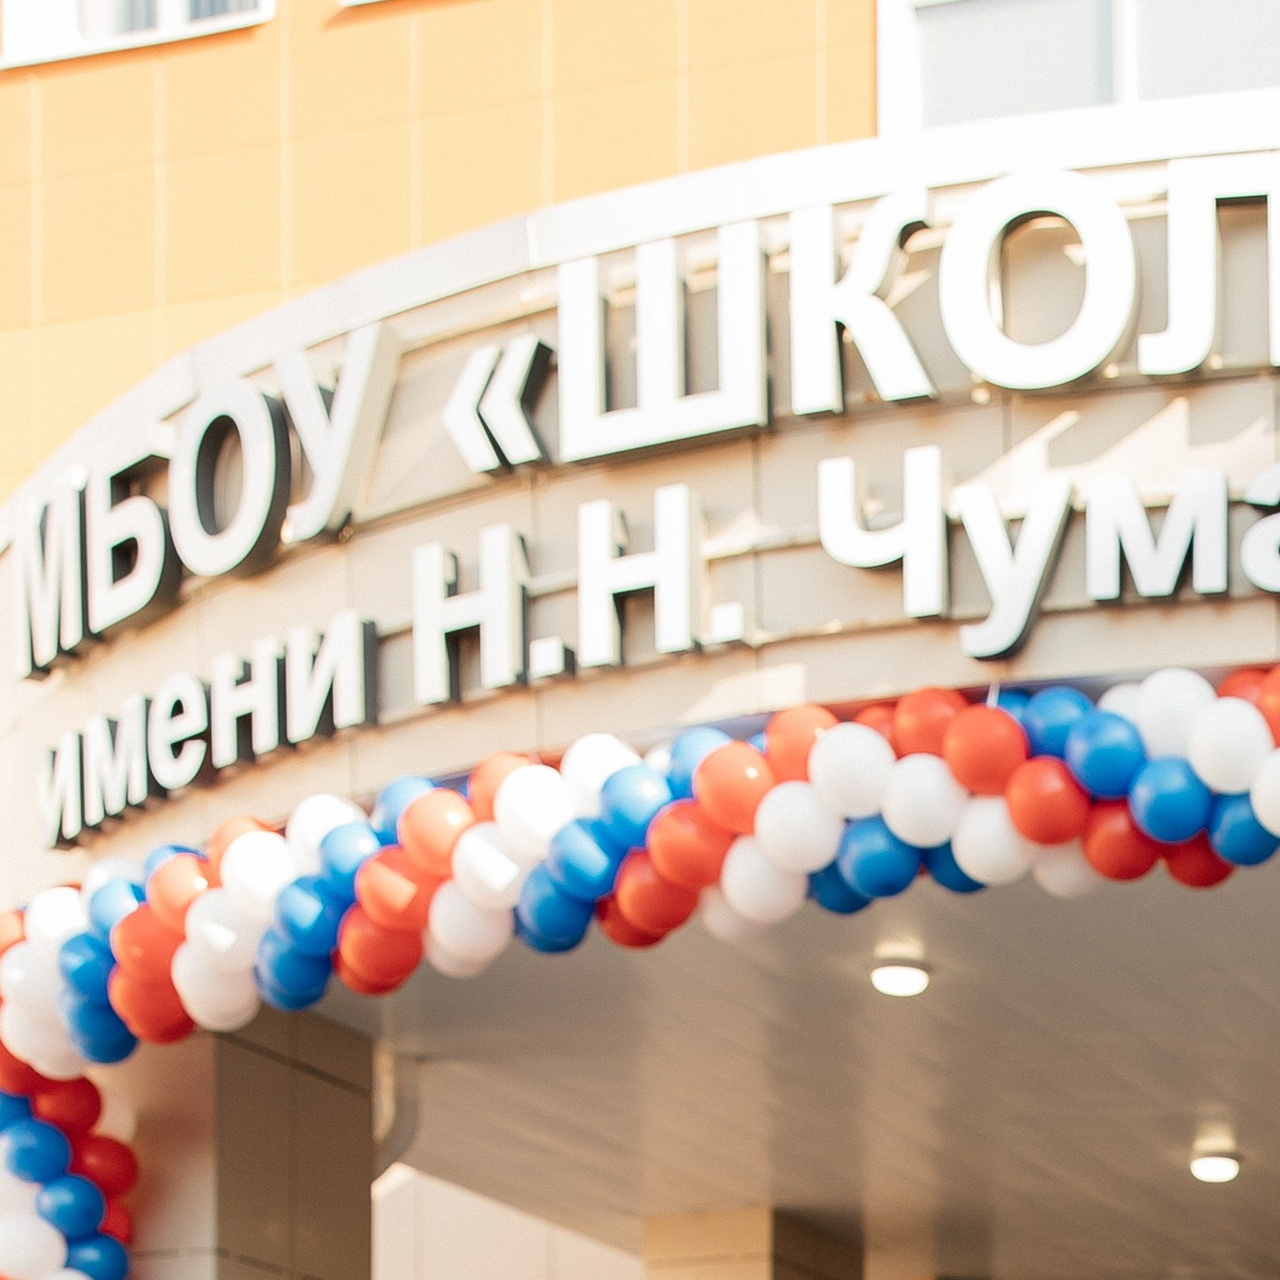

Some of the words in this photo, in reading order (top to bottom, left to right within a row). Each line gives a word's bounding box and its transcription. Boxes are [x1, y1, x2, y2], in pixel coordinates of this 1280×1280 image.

[14, 322, 392, 680] МБОУ
[42, 612, 376, 848] имени
[412, 484, 746, 706] Н.Н.
